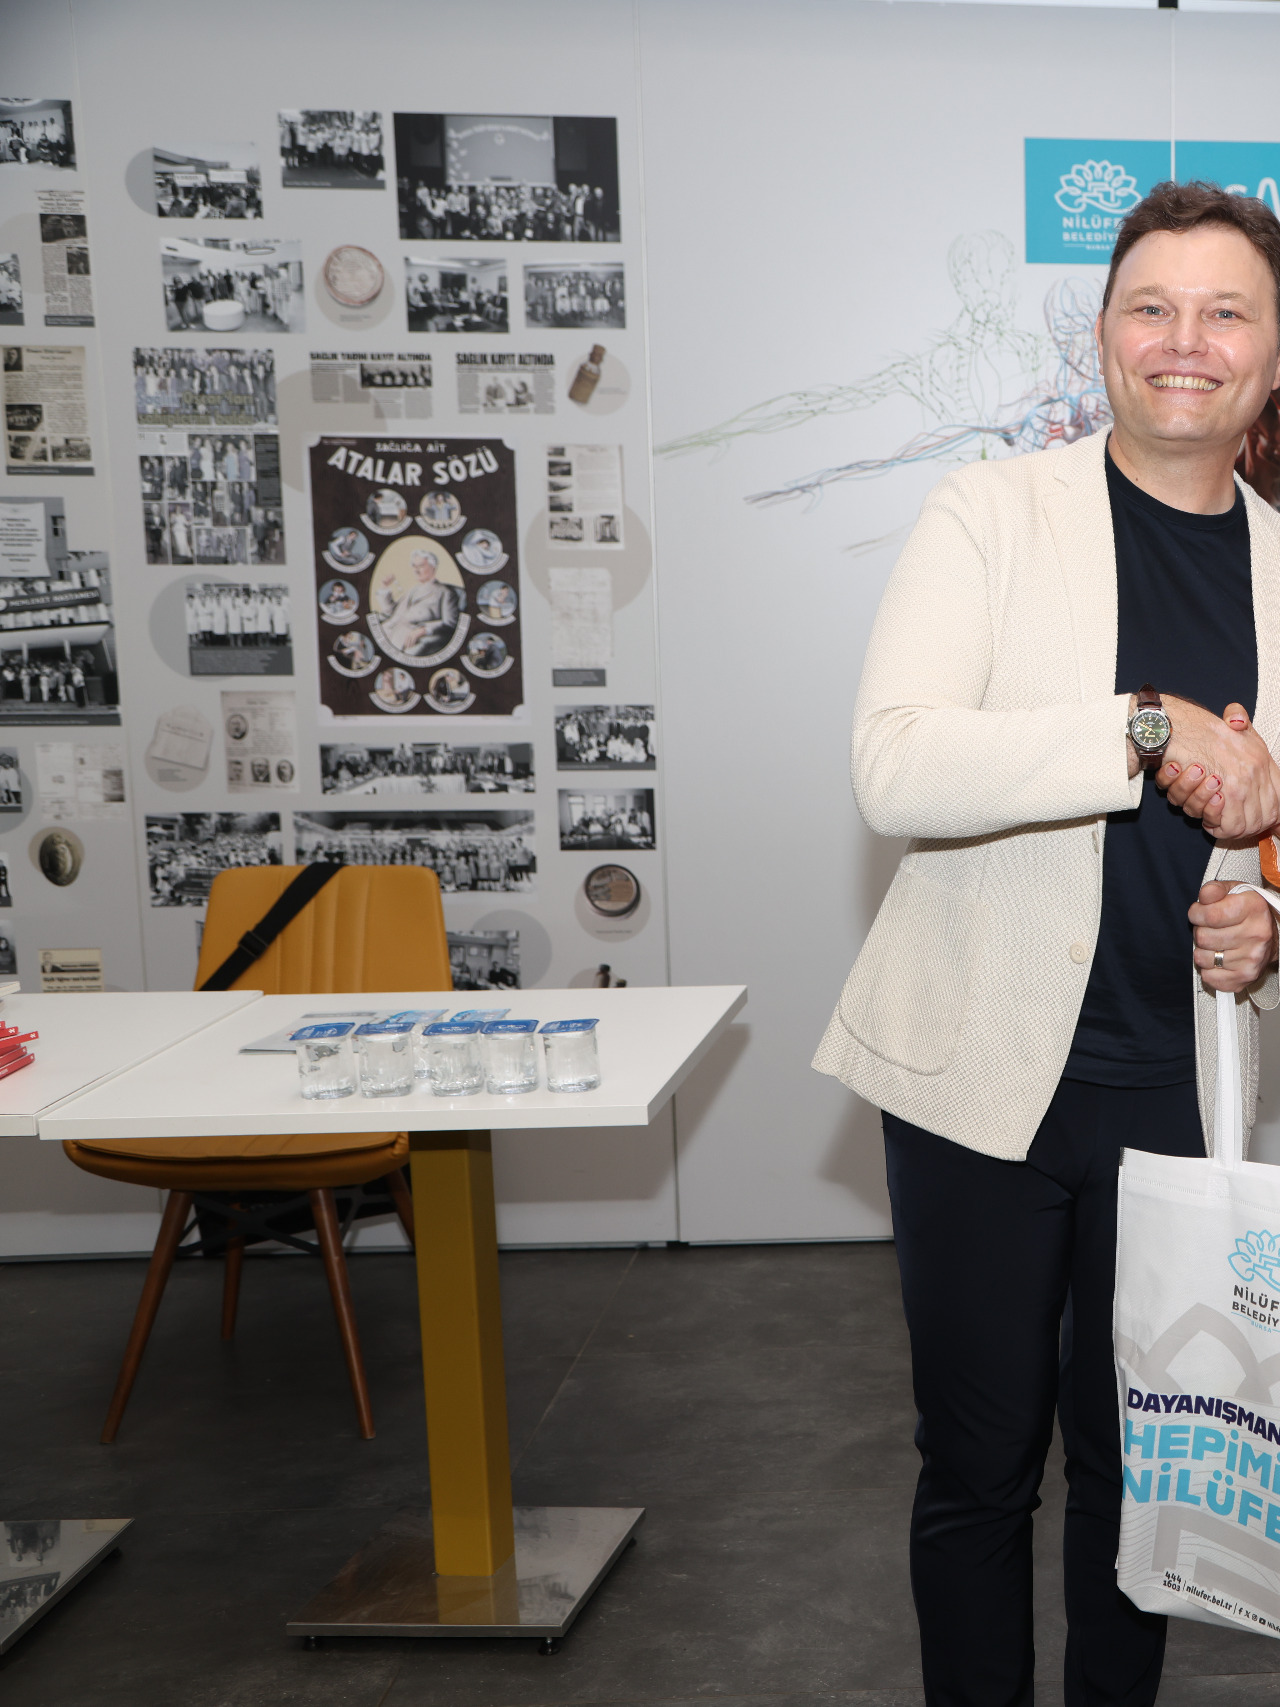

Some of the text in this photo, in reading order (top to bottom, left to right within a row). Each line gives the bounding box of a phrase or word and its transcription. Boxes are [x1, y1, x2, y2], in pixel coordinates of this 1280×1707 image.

[426, 440, 446, 453] AİT
[327, 445, 499, 487] ATALAR SÖZÜ
[1250, 1320, 1272, 1333] BURSA
[1165, 1571, 1182, 1584] 444
[1163, 1580, 1181, 1592] 1603
[1186, 1583, 1233, 1611] nilufer.bel.tr
